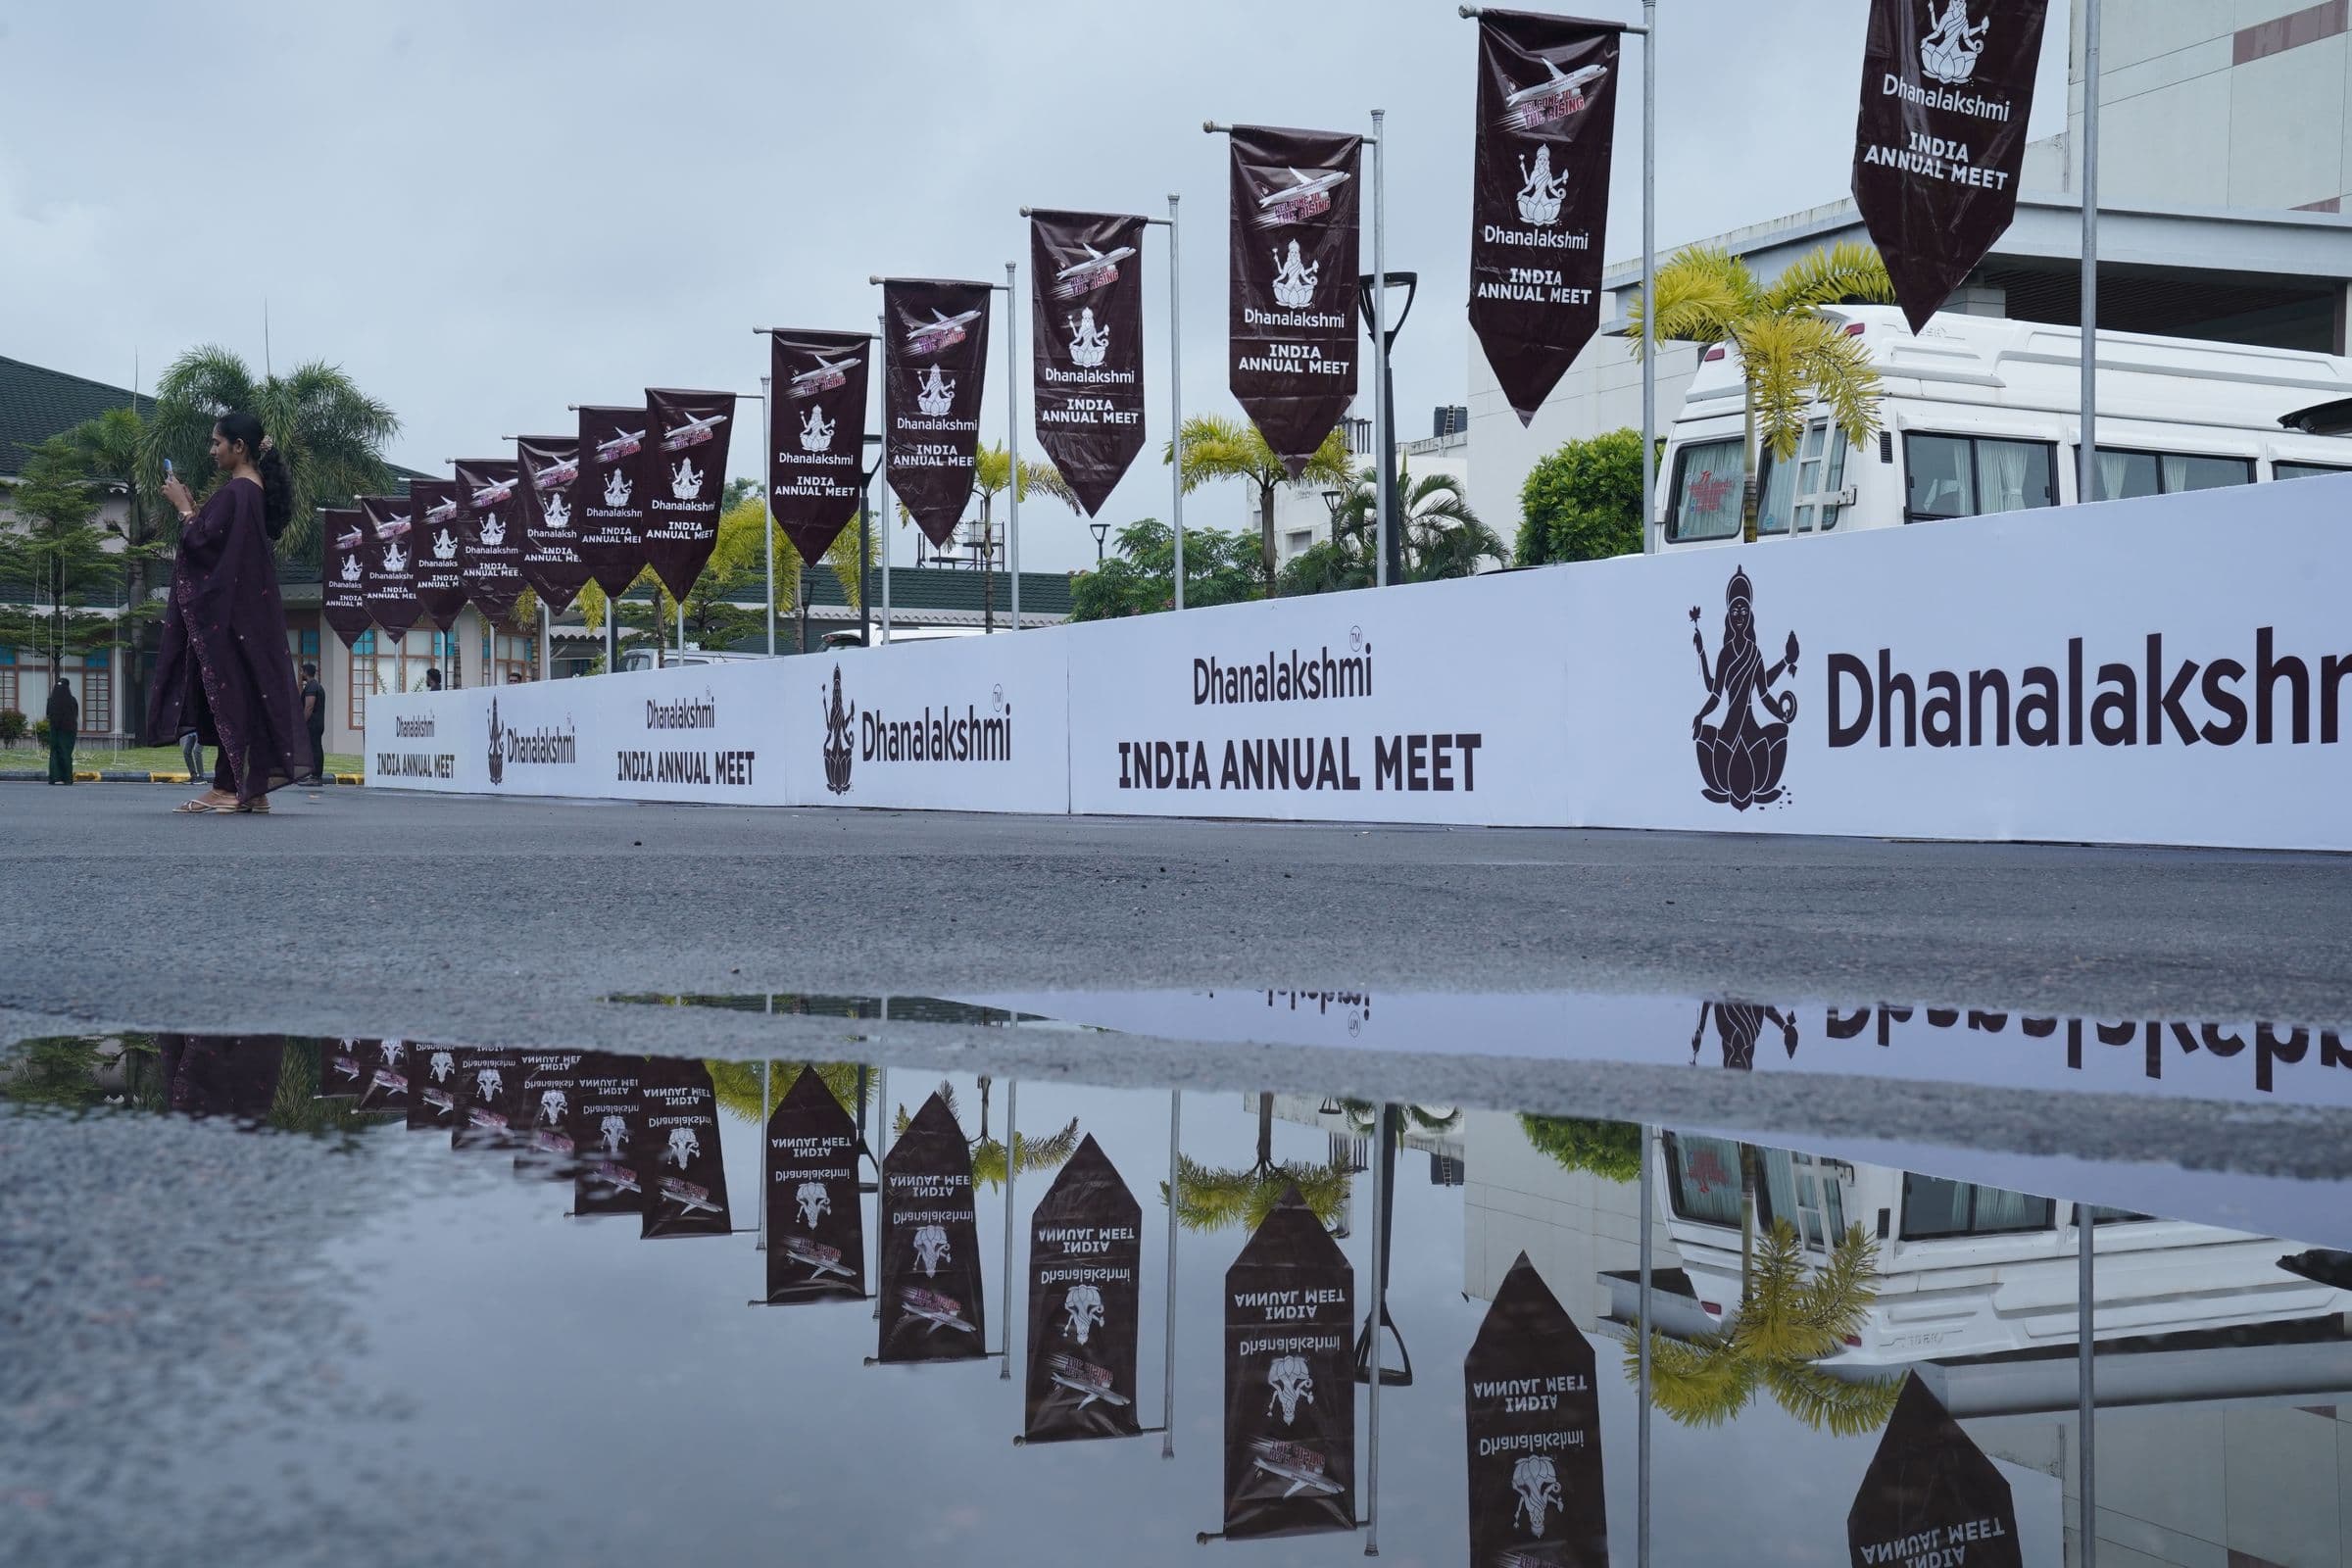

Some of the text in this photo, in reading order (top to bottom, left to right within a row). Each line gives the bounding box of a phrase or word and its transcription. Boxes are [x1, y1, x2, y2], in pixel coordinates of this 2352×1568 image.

[1883, 74, 2011, 122] Dhanalakshmi
[1908, 130, 1969, 163] INDIA
[1864, 144, 2009, 190] ANNUAL MEET
[1485, 224, 1589, 250] Dhanalakshmi
[1509, 268, 1562, 286] INDIA
[1477, 282, 1592, 305] ANNUAL MEET
[1245, 309, 1345, 328] Dhanalakshmi
[1269, 344, 1321, 359] INDIA
[1239, 358, 1349, 375] ANNUAL MEET
[1045, 368, 1135, 384] Dhanalakshmi
[1067, 399, 1114, 412] INDIA
[897, 417, 978, 431] Dhanalakshmi
[1042, 411, 1138, 424] ANNUAL MEET
[779, 453, 854, 466] Dhanalakshmi
[916, 445, 957, 456] INDIA
[893, 455, 974, 466] ANNUAL MEE
[797, 476, 835, 486] INDIA
[775, 486, 855, 497] ANNUAL MEET
[527, 529, 577, 538] Dhanalaksh
[646, 529, 714, 540] ANNUAL MEET
[668, 521, 703, 530] INDIA
[328, 580, 362, 589] Dhanalaks
[1194, 642, 1372, 705] Dhanalakshmi
[1828, 626, 2352, 748] Dhanalaksh
[647, 696, 714, 729] Dhanalakshmi
[396, 713, 435, 738] Dhanalakshmi
[861, 704, 1011, 762] Dhanalakshmi
[507, 725, 575, 763] Dhanalakshmi
[377, 753, 455, 778] INDIA ANNUAL MEET
[617, 751, 755, 785] INDIA ANNUAL MEET
[1118, 734, 1482, 791] INDIA ANNUAL MEET
